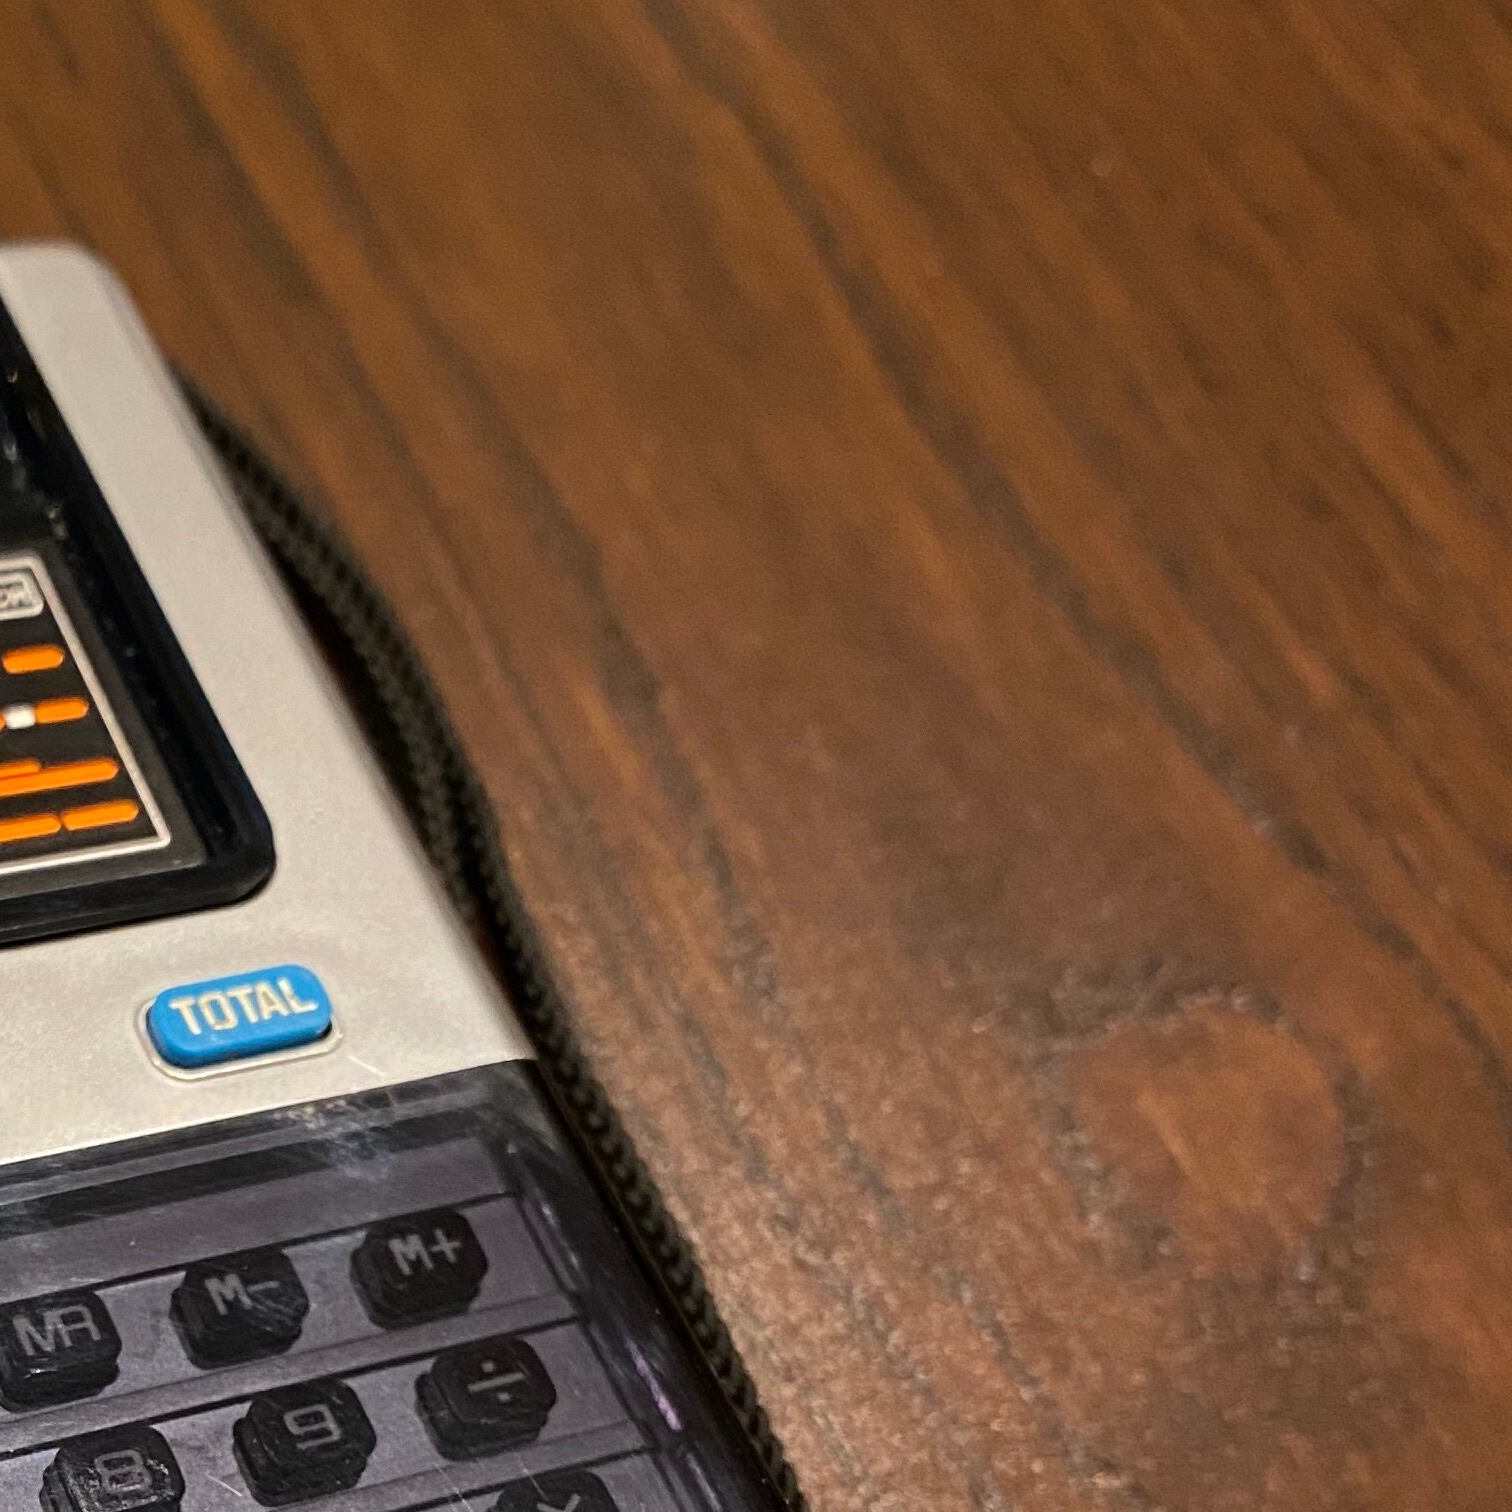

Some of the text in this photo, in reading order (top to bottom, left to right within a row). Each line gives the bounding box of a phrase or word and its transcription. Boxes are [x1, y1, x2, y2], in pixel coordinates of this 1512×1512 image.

[168, 976, 320, 1036] TOTAL
[388, 1229, 462, 1276] M+
[282, 1403, 336, 1450] 9
[92, 1448, 154, 1496] 8
